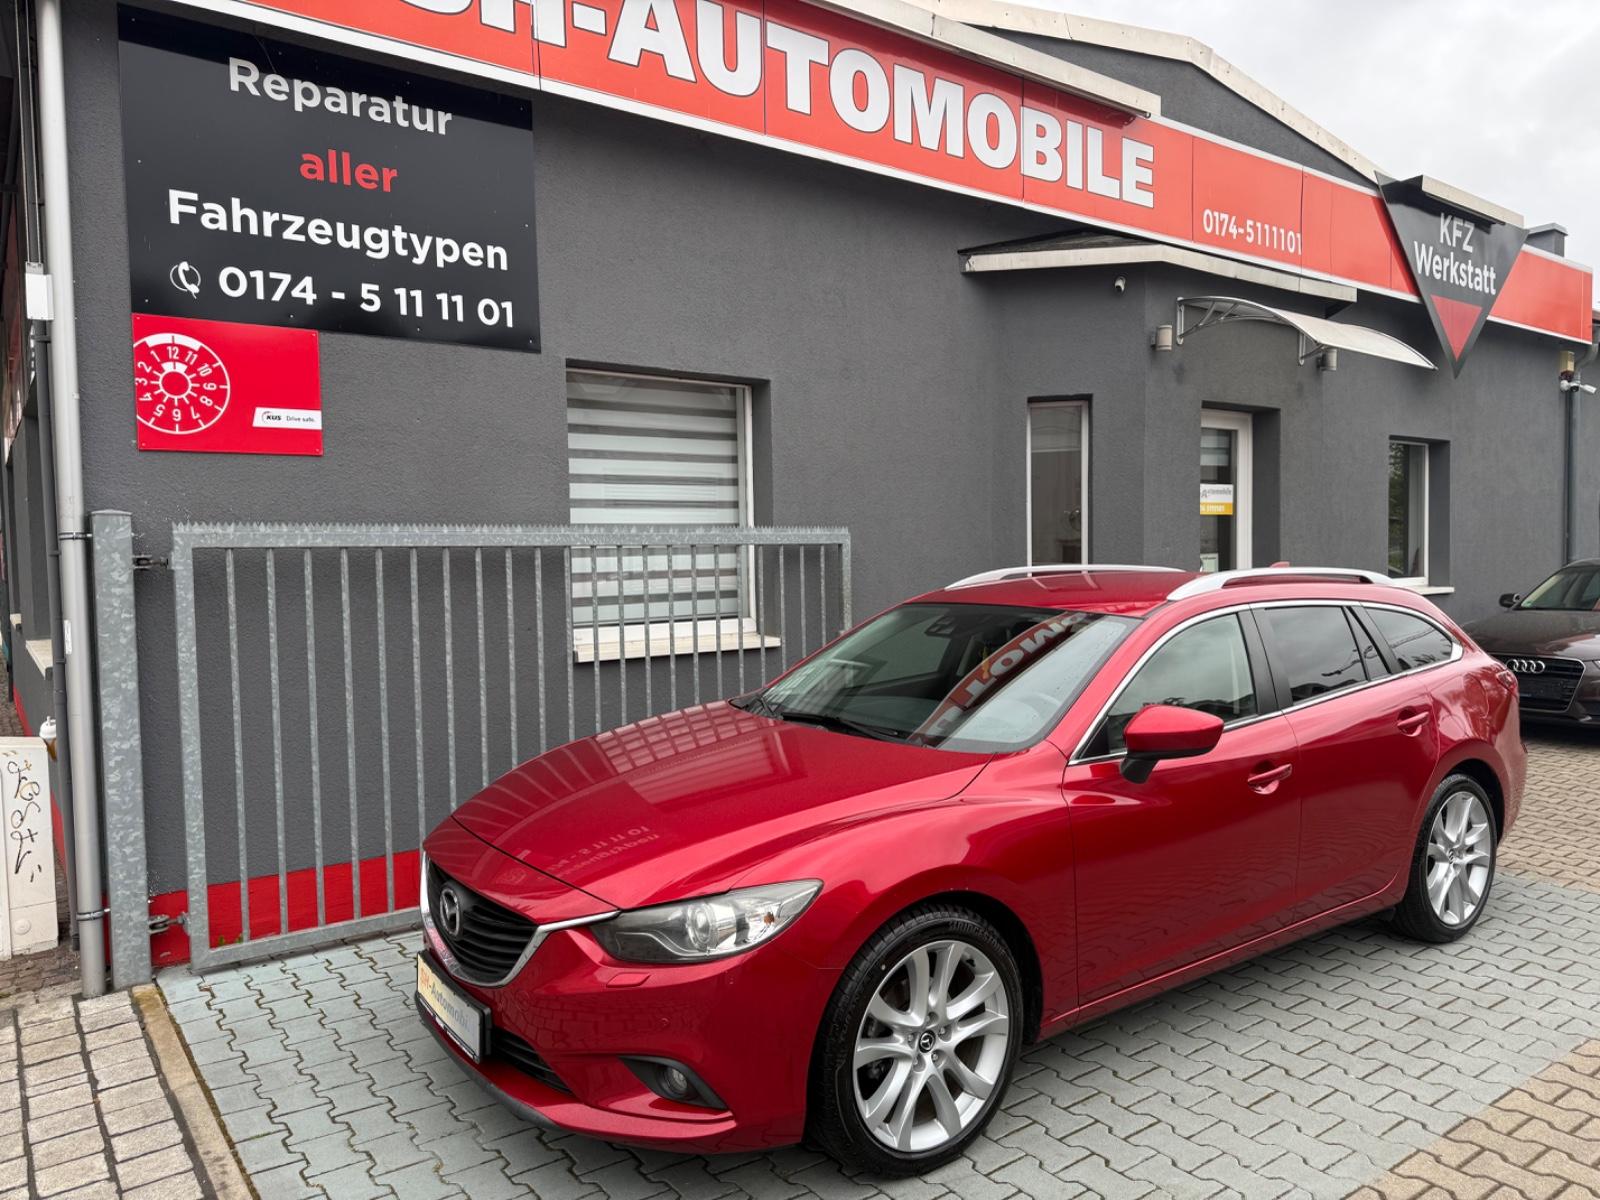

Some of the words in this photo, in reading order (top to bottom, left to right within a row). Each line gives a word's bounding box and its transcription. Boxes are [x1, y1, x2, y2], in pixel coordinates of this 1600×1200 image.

[228, 56, 453, 135] Reparatur
[402, 0, 1155, 209] -AUTOMOBILE
[299, 148, 398, 193] aller
[168, 188, 509, 271] Fahrzeugtypen
[1202, 208, 1302, 256] 0174-5111101
[1439, 211, 1475, 254] KFZ
[1413, 240, 1497, 296] Werkstatt
[218, 266, 317, 306] 0174
[331, 290, 346, 300] -
[359, 282, 382, 313] 5
[394, 287, 424, 318] 11
[435, 292, 464, 323] 11
[477, 297, 514, 329] 01
[149, 349, 161, 363] 1
[166, 346, 180, 360] 12
[184, 350, 199, 366] 11
[136, 360, 152, 374] 2
[196, 363, 213, 378] 10
[134, 376, 149, 387] 3
[202, 381, 218, 392] 9
[138, 391, 153, 402] 4
[199, 394, 214, 408] 8
[153, 403, 166, 418] 5
[171, 408, 182, 422] 6
[189, 405, 201, 421] 7
